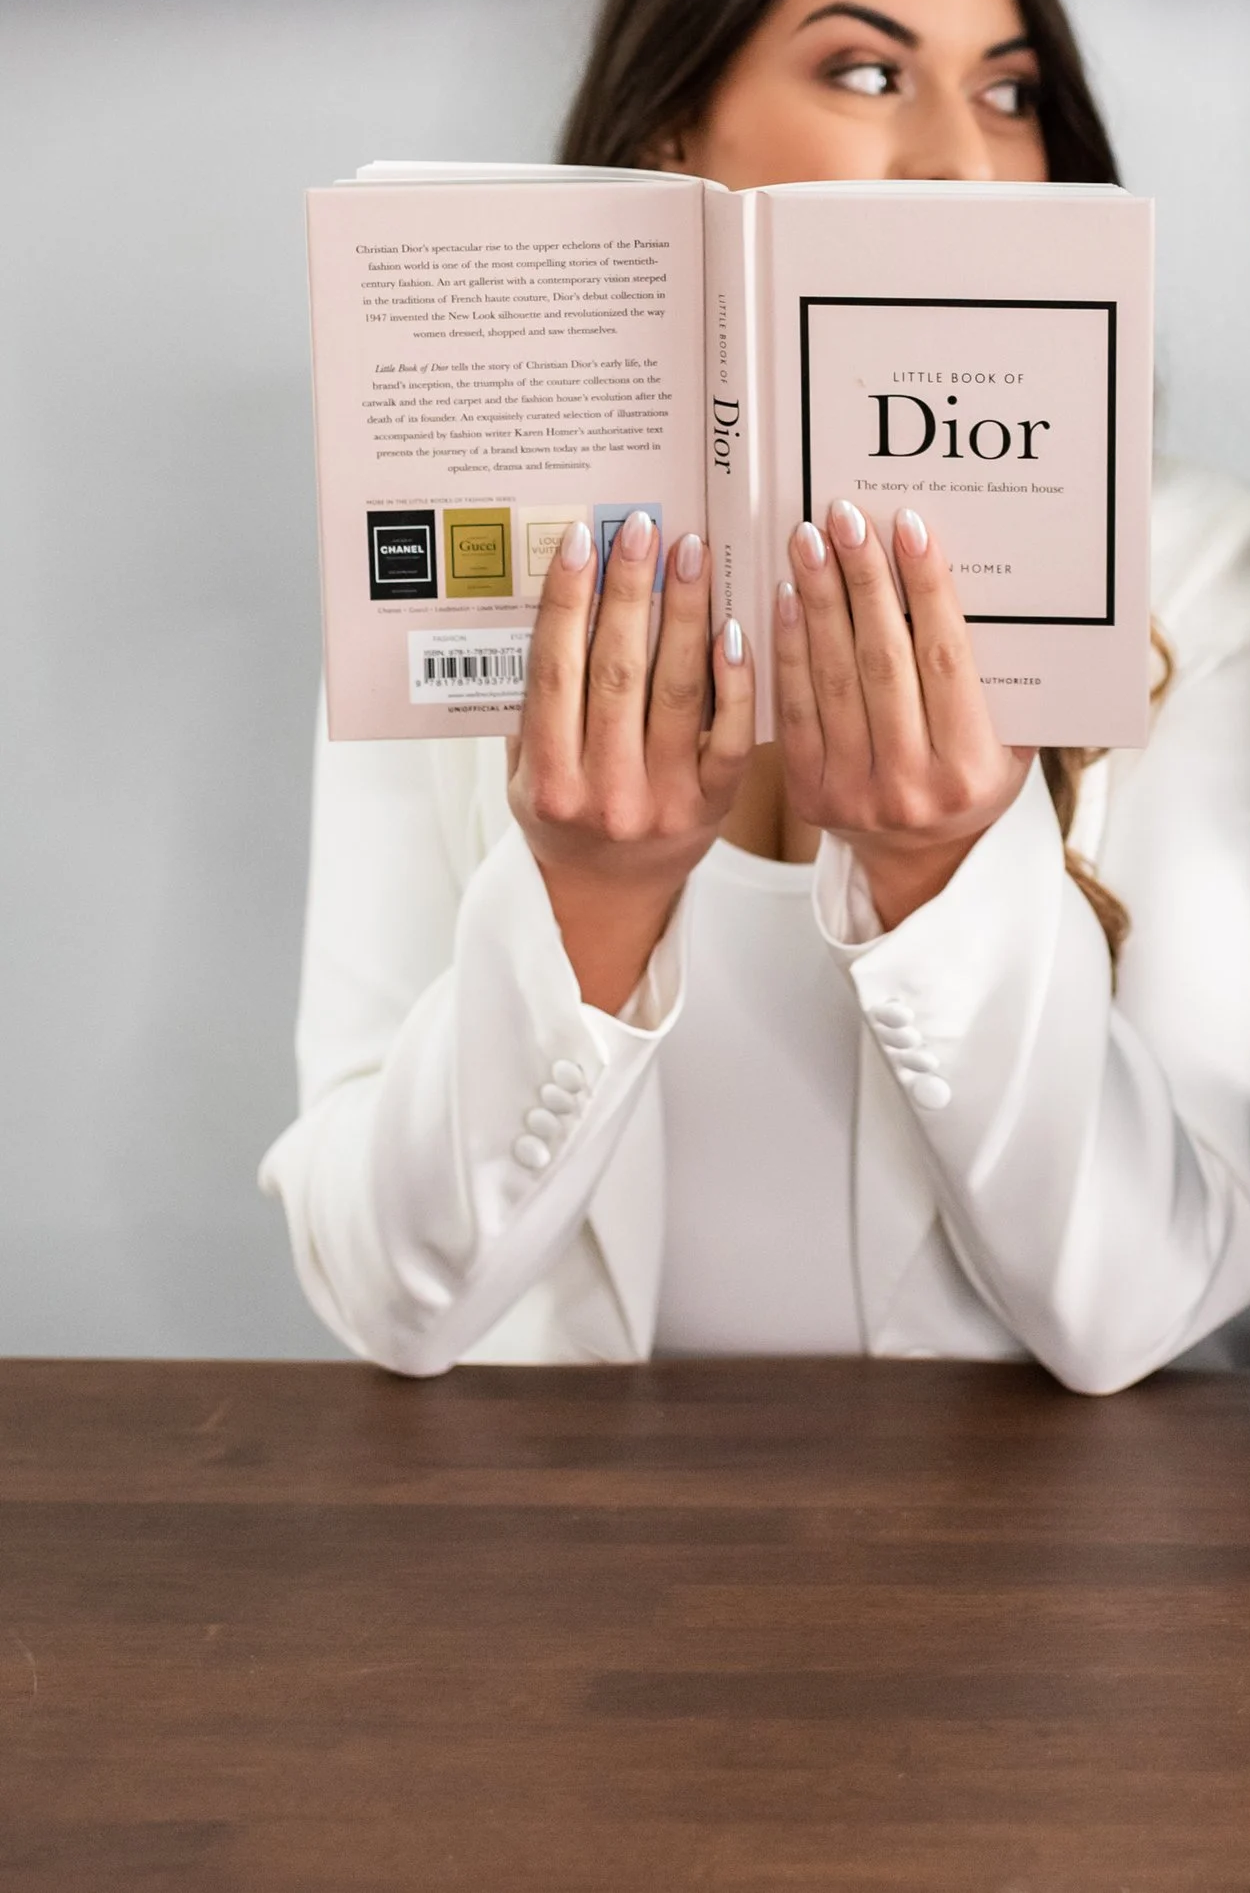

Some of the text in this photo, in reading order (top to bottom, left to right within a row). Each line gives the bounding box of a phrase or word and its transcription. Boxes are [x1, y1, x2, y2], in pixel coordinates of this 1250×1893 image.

[356, 240, 670, 255] Christian Dior's spectacular rise to the upper echelons of the Parisian
[368, 262, 402, 271] fashion
[404, 261, 430, 270] world
[432, 261, 439, 270] is
[460, 260, 471, 269] of
[474, 260, 489, 269] the
[492, 260, 514, 268] most
[516, 259, 567, 270] compelling
[568, 258, 598, 267] stories
[600, 258, 609, 266] of
[612, 257, 658, 266] twentieth-
[360, 280, 397, 290] century
[398, 279, 433, 288] fashion.
[436, 278, 451, 287] An
[454, 278, 466, 287] art
[468, 277, 504, 289] gallerist
[506, 277, 527, 286] with
[536, 276, 601, 287] contemporary
[604, 275, 630, 284] vision
[632, 274, 667, 285] steeped
[362, 290, 666, 305] in the traditions of French haute couture, Dior's debut collection in
[366, 308, 665, 322] 1947 invented the New Look silhouette and revolutionized the way
[448, 328, 485, 337] dressed,
[488, 327, 526, 338] shopped
[528, 327, 546, 335] and
[568, 326, 617, 335] themselves.
[719, 334, 727, 365] BOOK
[894, 372, 1023, 384] LITTLE BOOK OF
[868, 394, 1050, 460] Dior
[713, 395, 740, 474] Dior
[855, 480, 1064, 495] The story of the iconic fashion house
[380, 545, 425, 554] CHANEL
[459, 540, 497, 552] Gucci
[961, 564, 1012, 574] HOMER
